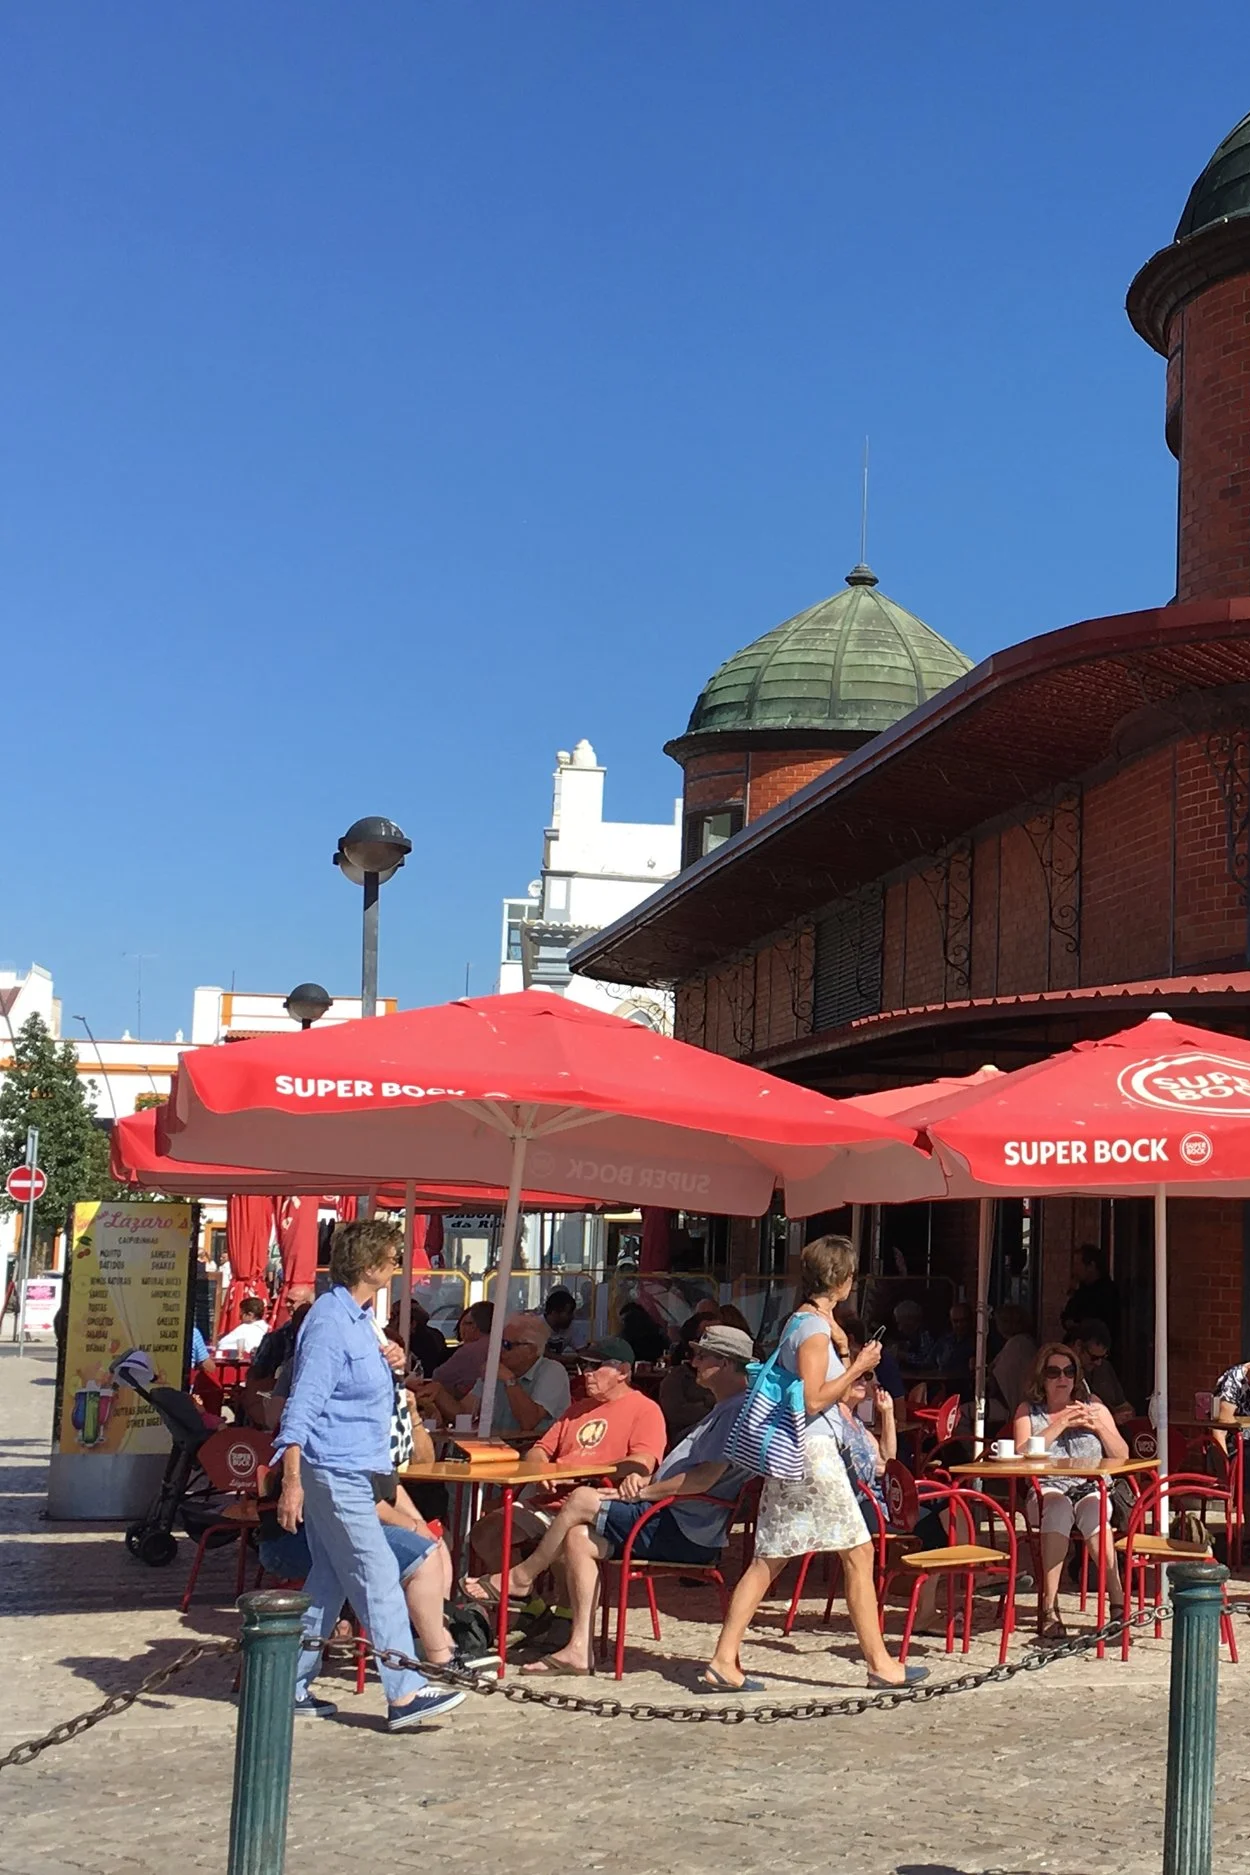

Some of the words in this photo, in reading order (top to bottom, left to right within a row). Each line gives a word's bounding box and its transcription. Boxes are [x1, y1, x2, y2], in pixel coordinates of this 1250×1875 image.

[275, 1075, 374, 1098] SUPER
[381, 1082, 467, 1098] BOCK
[1003, 1140, 1088, 1166] SUPER
[1093, 1137, 1169, 1163] BOCK
[1186, 1147, 1206, 1155] BOCK
